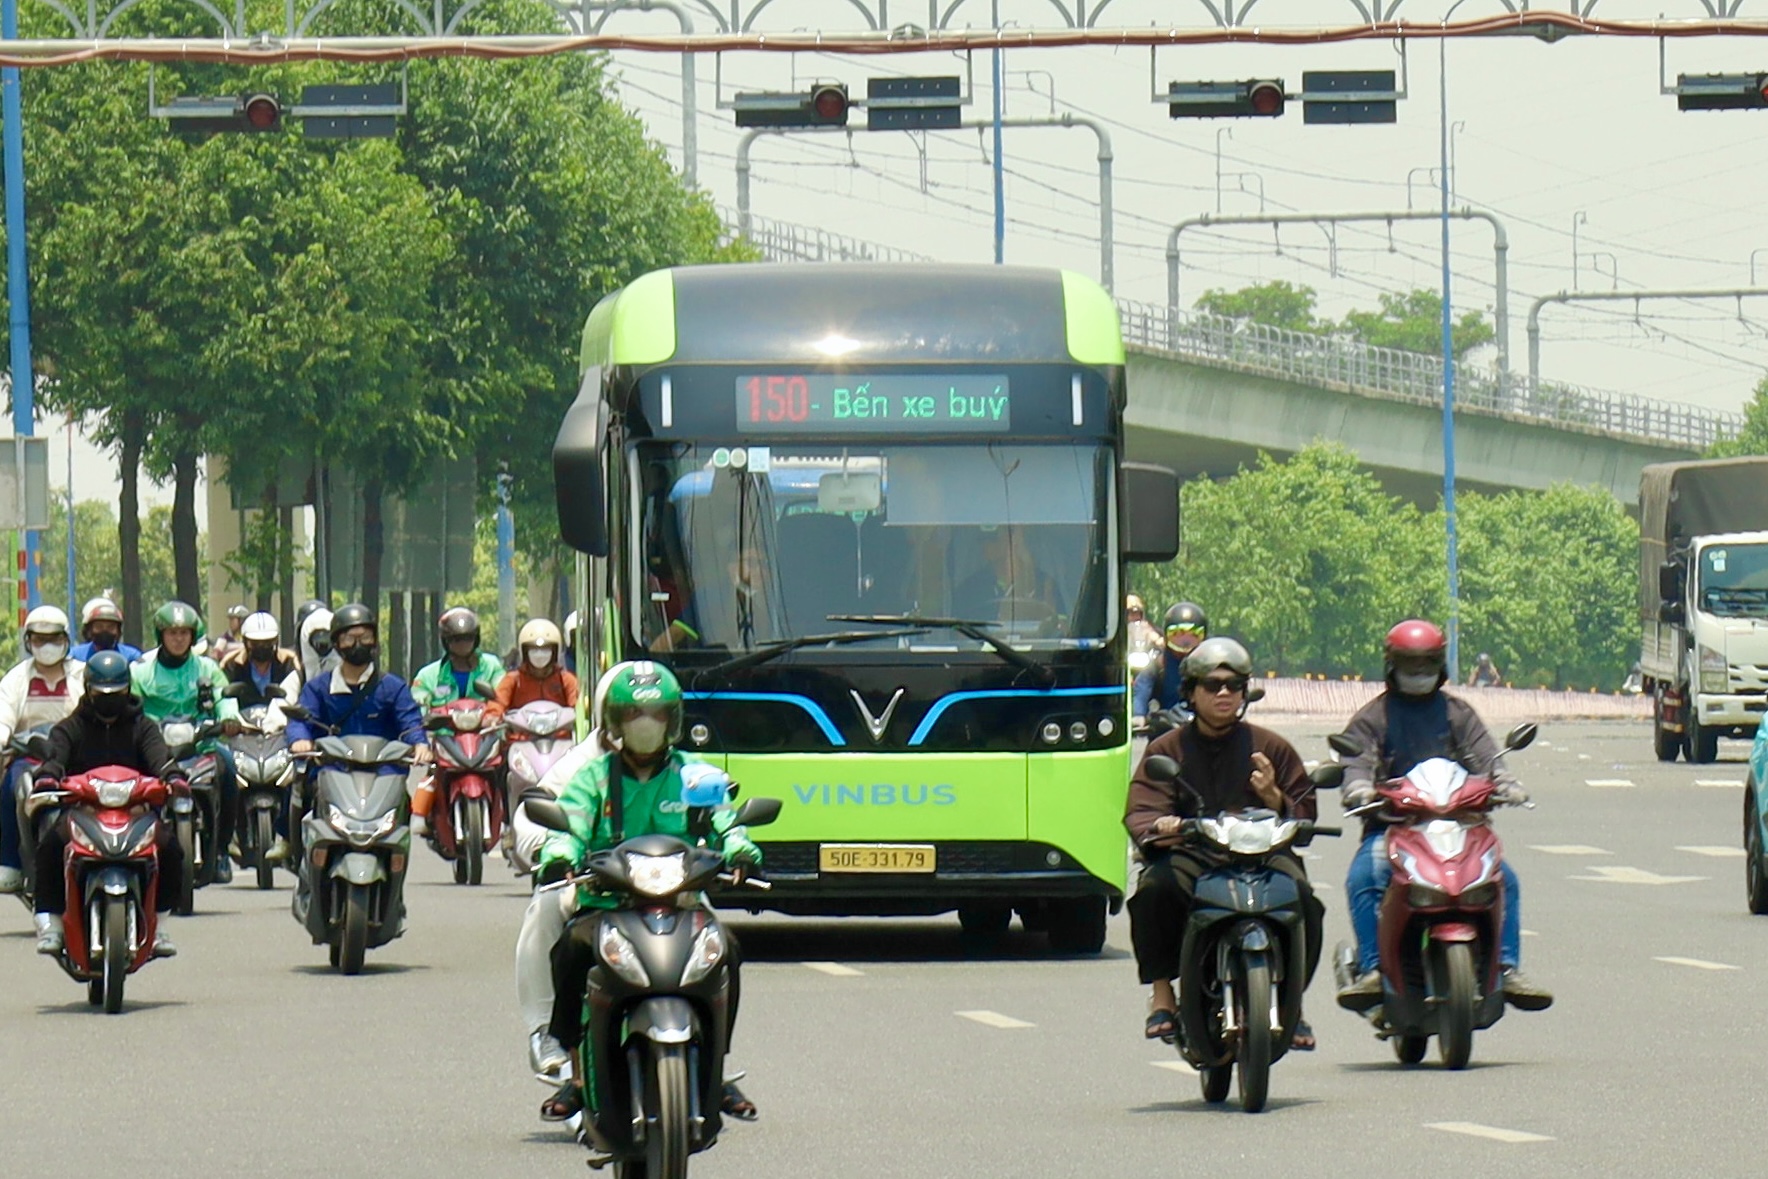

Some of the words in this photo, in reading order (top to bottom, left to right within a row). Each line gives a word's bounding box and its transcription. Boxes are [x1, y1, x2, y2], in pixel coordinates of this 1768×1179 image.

[745, 375, 808, 422] 150
[833, 382, 888, 418] Bến
[902, 395, 936, 418] xe
[793, 783, 957, 806] VINBUS
